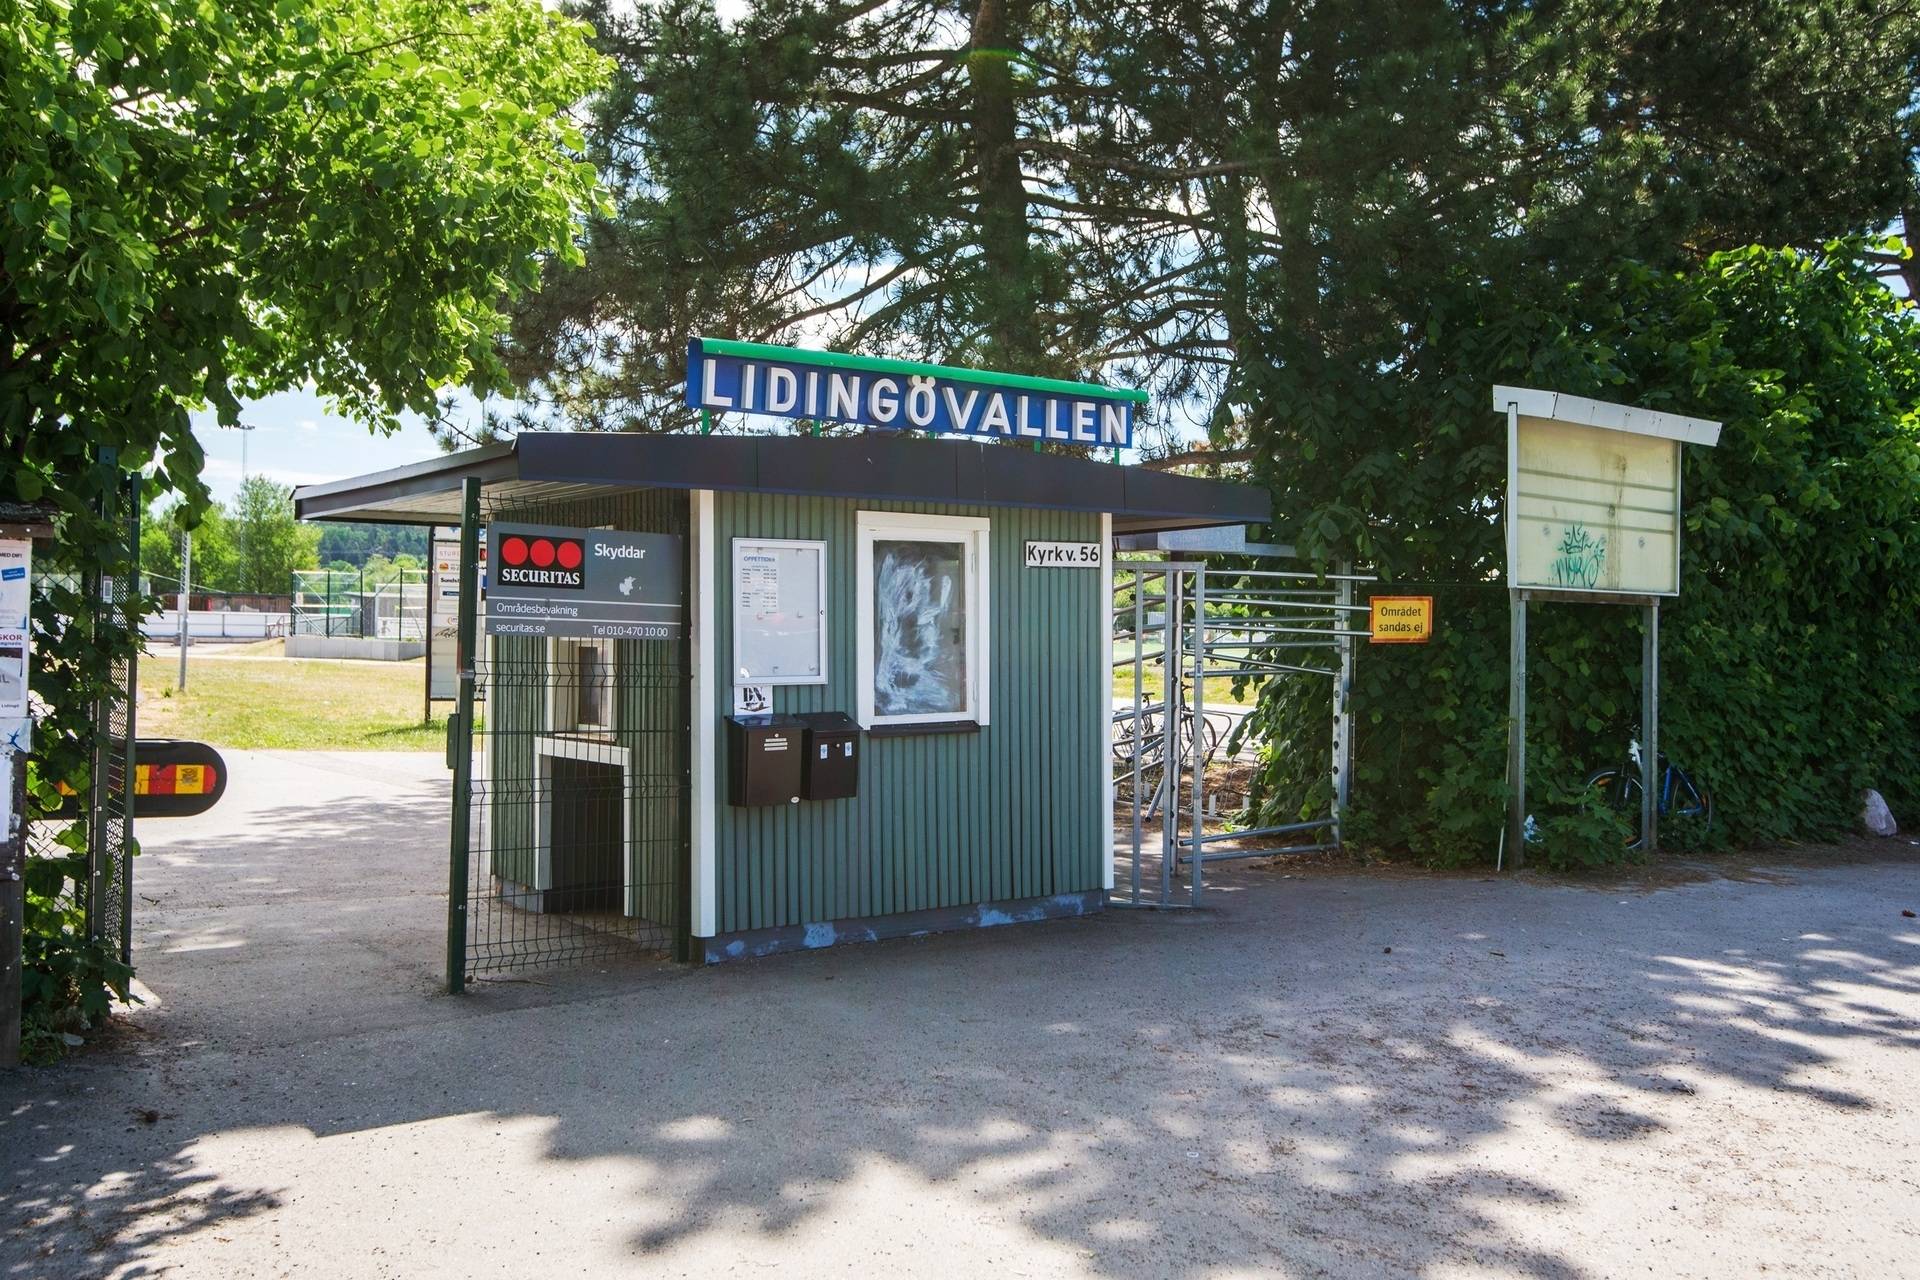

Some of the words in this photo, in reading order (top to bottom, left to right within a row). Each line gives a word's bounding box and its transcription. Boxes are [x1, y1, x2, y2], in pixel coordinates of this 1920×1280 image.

[702, 359, 1127, 444] LIDINGÖVALLEN
[594, 543, 646, 560] Skyddar
[1028, 545, 1063, 565] Kyrk
[1066, 550, 1076, 562] v.
[1080, 546, 1099, 562] 56
[502, 568, 580, 585] SECURITAS
[496, 602, 578, 617] Områdesbevakning
[1381, 606, 1422, 617] Området
[496, 623, 546, 633] securitas.se
[592, 625, 606, 635] Tel
[606, 625, 643, 637] 010-470
[1379, 622, 1411, 632] sandas
[1414, 622, 1423, 634] ej
